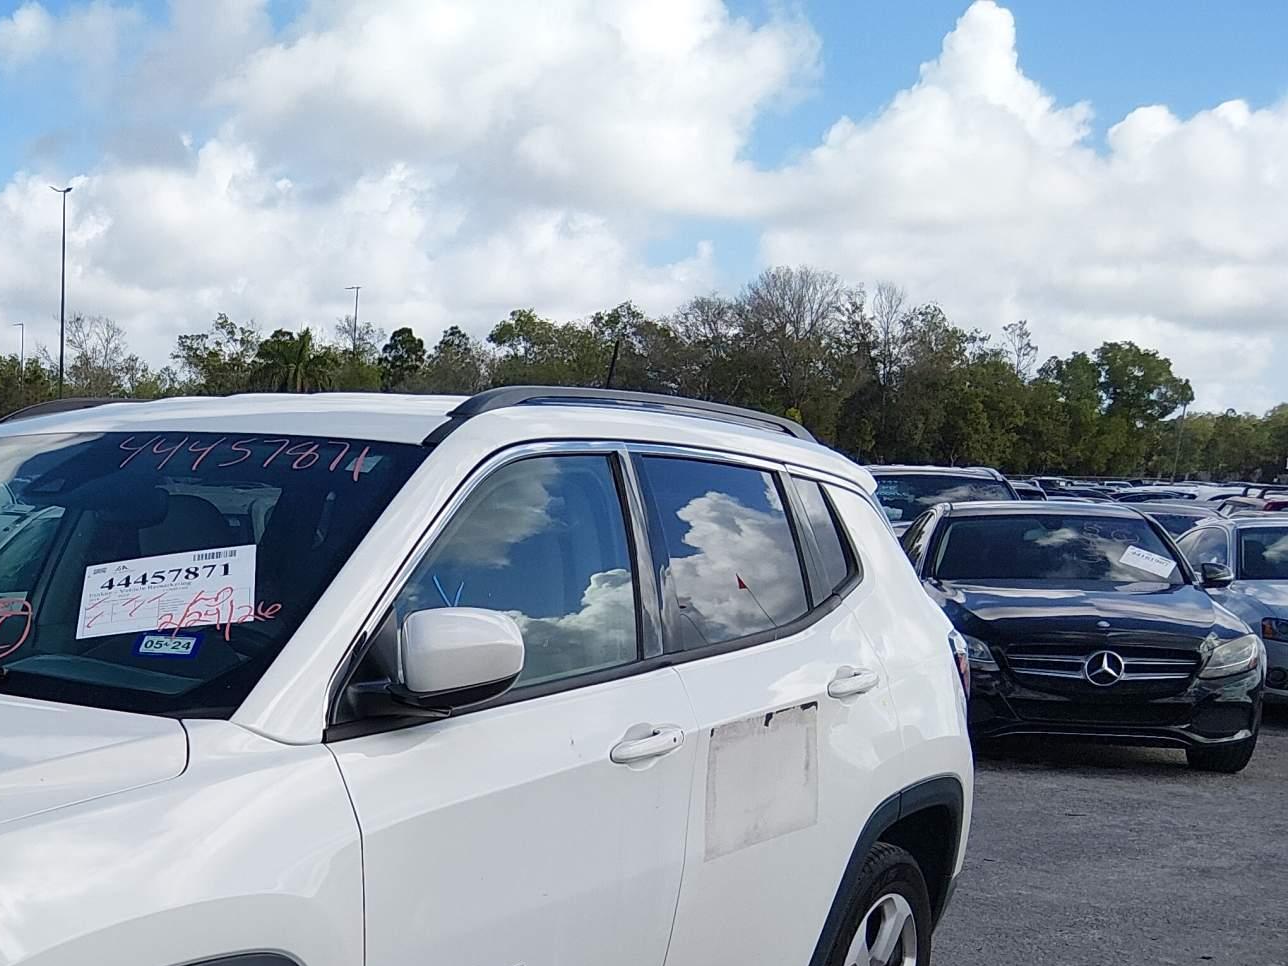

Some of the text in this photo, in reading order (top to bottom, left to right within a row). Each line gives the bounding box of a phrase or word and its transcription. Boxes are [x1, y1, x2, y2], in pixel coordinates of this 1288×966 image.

[119, 436, 370, 481] 44457871
[100, 563, 233, 590] 44457871
[171, 641, 191, 650] 24
